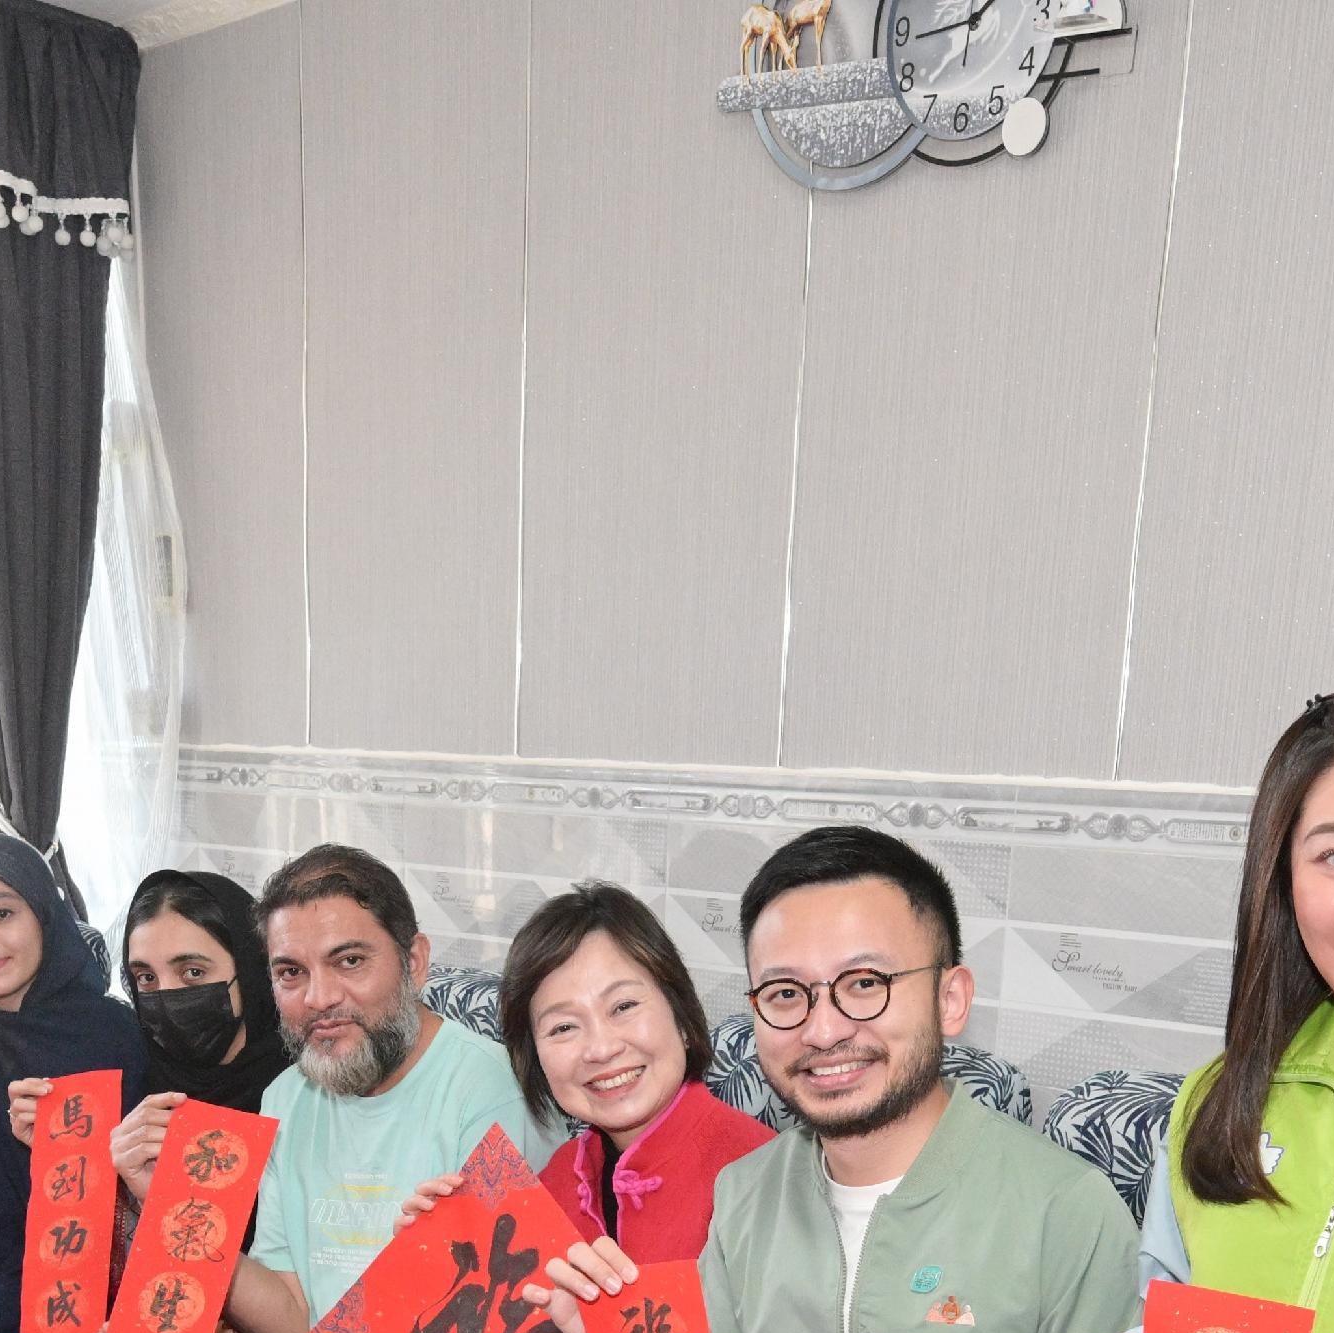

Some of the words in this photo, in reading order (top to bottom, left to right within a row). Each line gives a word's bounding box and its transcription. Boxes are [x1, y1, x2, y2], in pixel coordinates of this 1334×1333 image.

[895, 16, 911, 47] 9
[1019, 46, 1035, 76] 4
[899, 62, 915, 92] 8
[923, 94, 938, 123] 7
[988, 85, 1005, 115] 5
[953, 102, 969, 133] 6
[47, 1095, 93, 1328] 馬到功成
